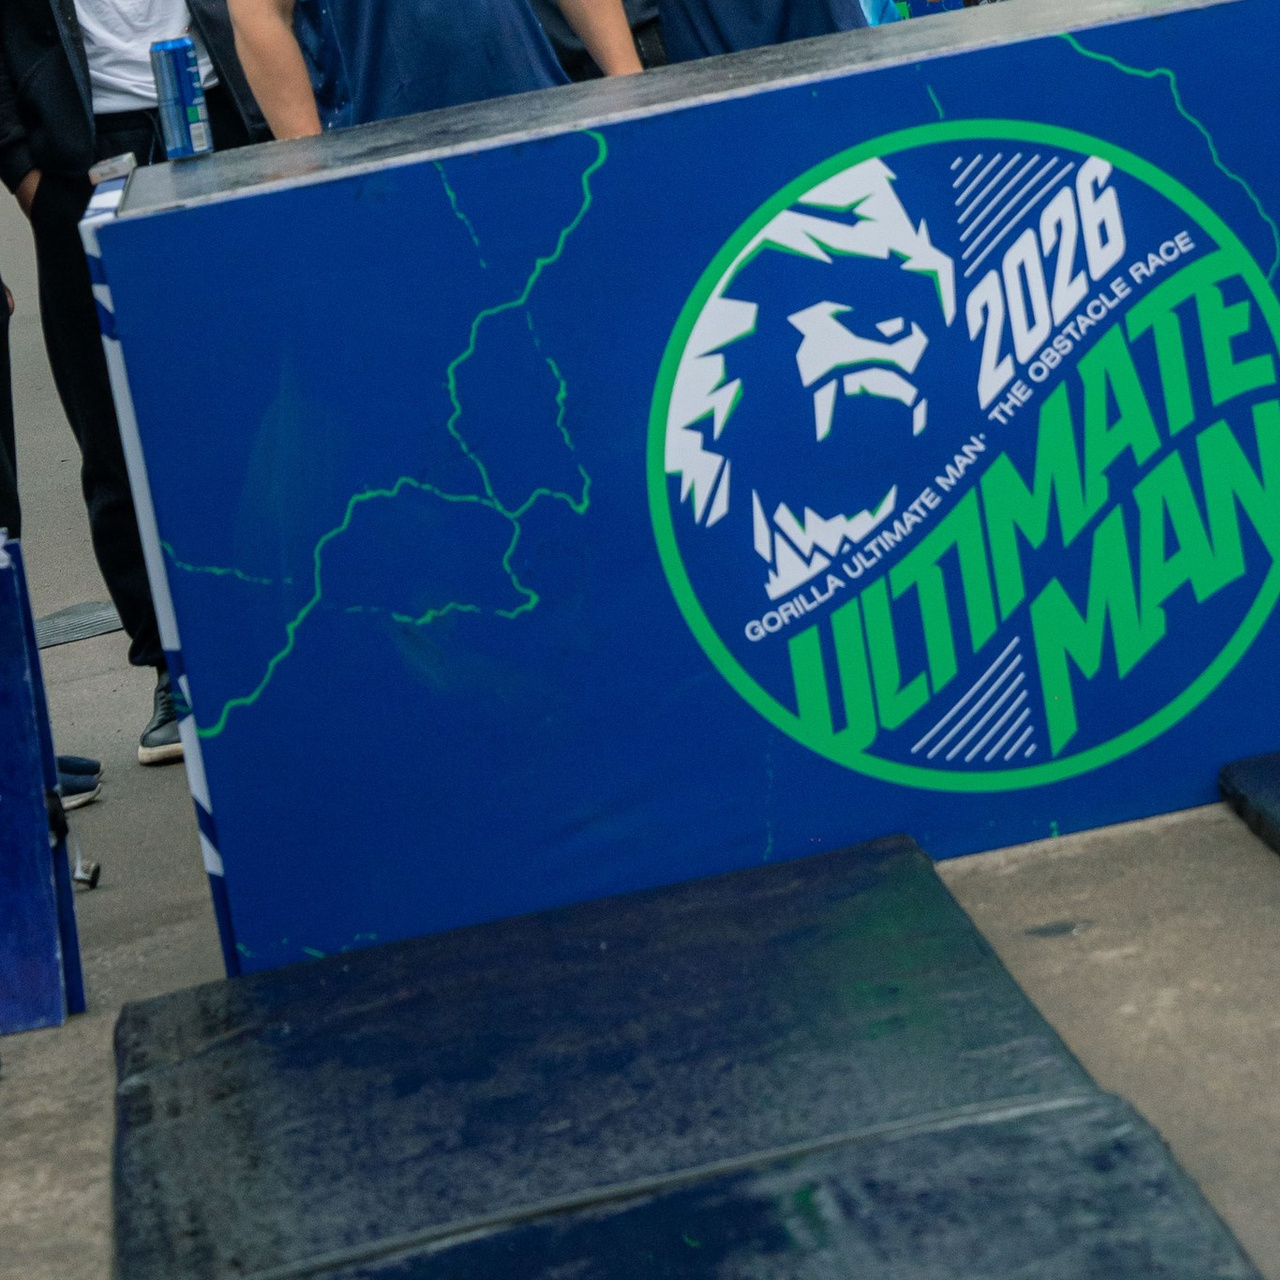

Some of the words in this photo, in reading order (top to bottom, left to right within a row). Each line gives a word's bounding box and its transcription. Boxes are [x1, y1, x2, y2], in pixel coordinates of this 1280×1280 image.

[744, 573, 846, 643] GORILLA
[842, 488, 942, 584] ULTIMATE
[987, 384, 1034, 427] THE
[1028, 278, 1132, 383] OBSTACLE
[1128, 230, 1196, 282] RACE
[966, 154, 1126, 410] 2026
[787, 258, 1278, 754] ULTIMATE
